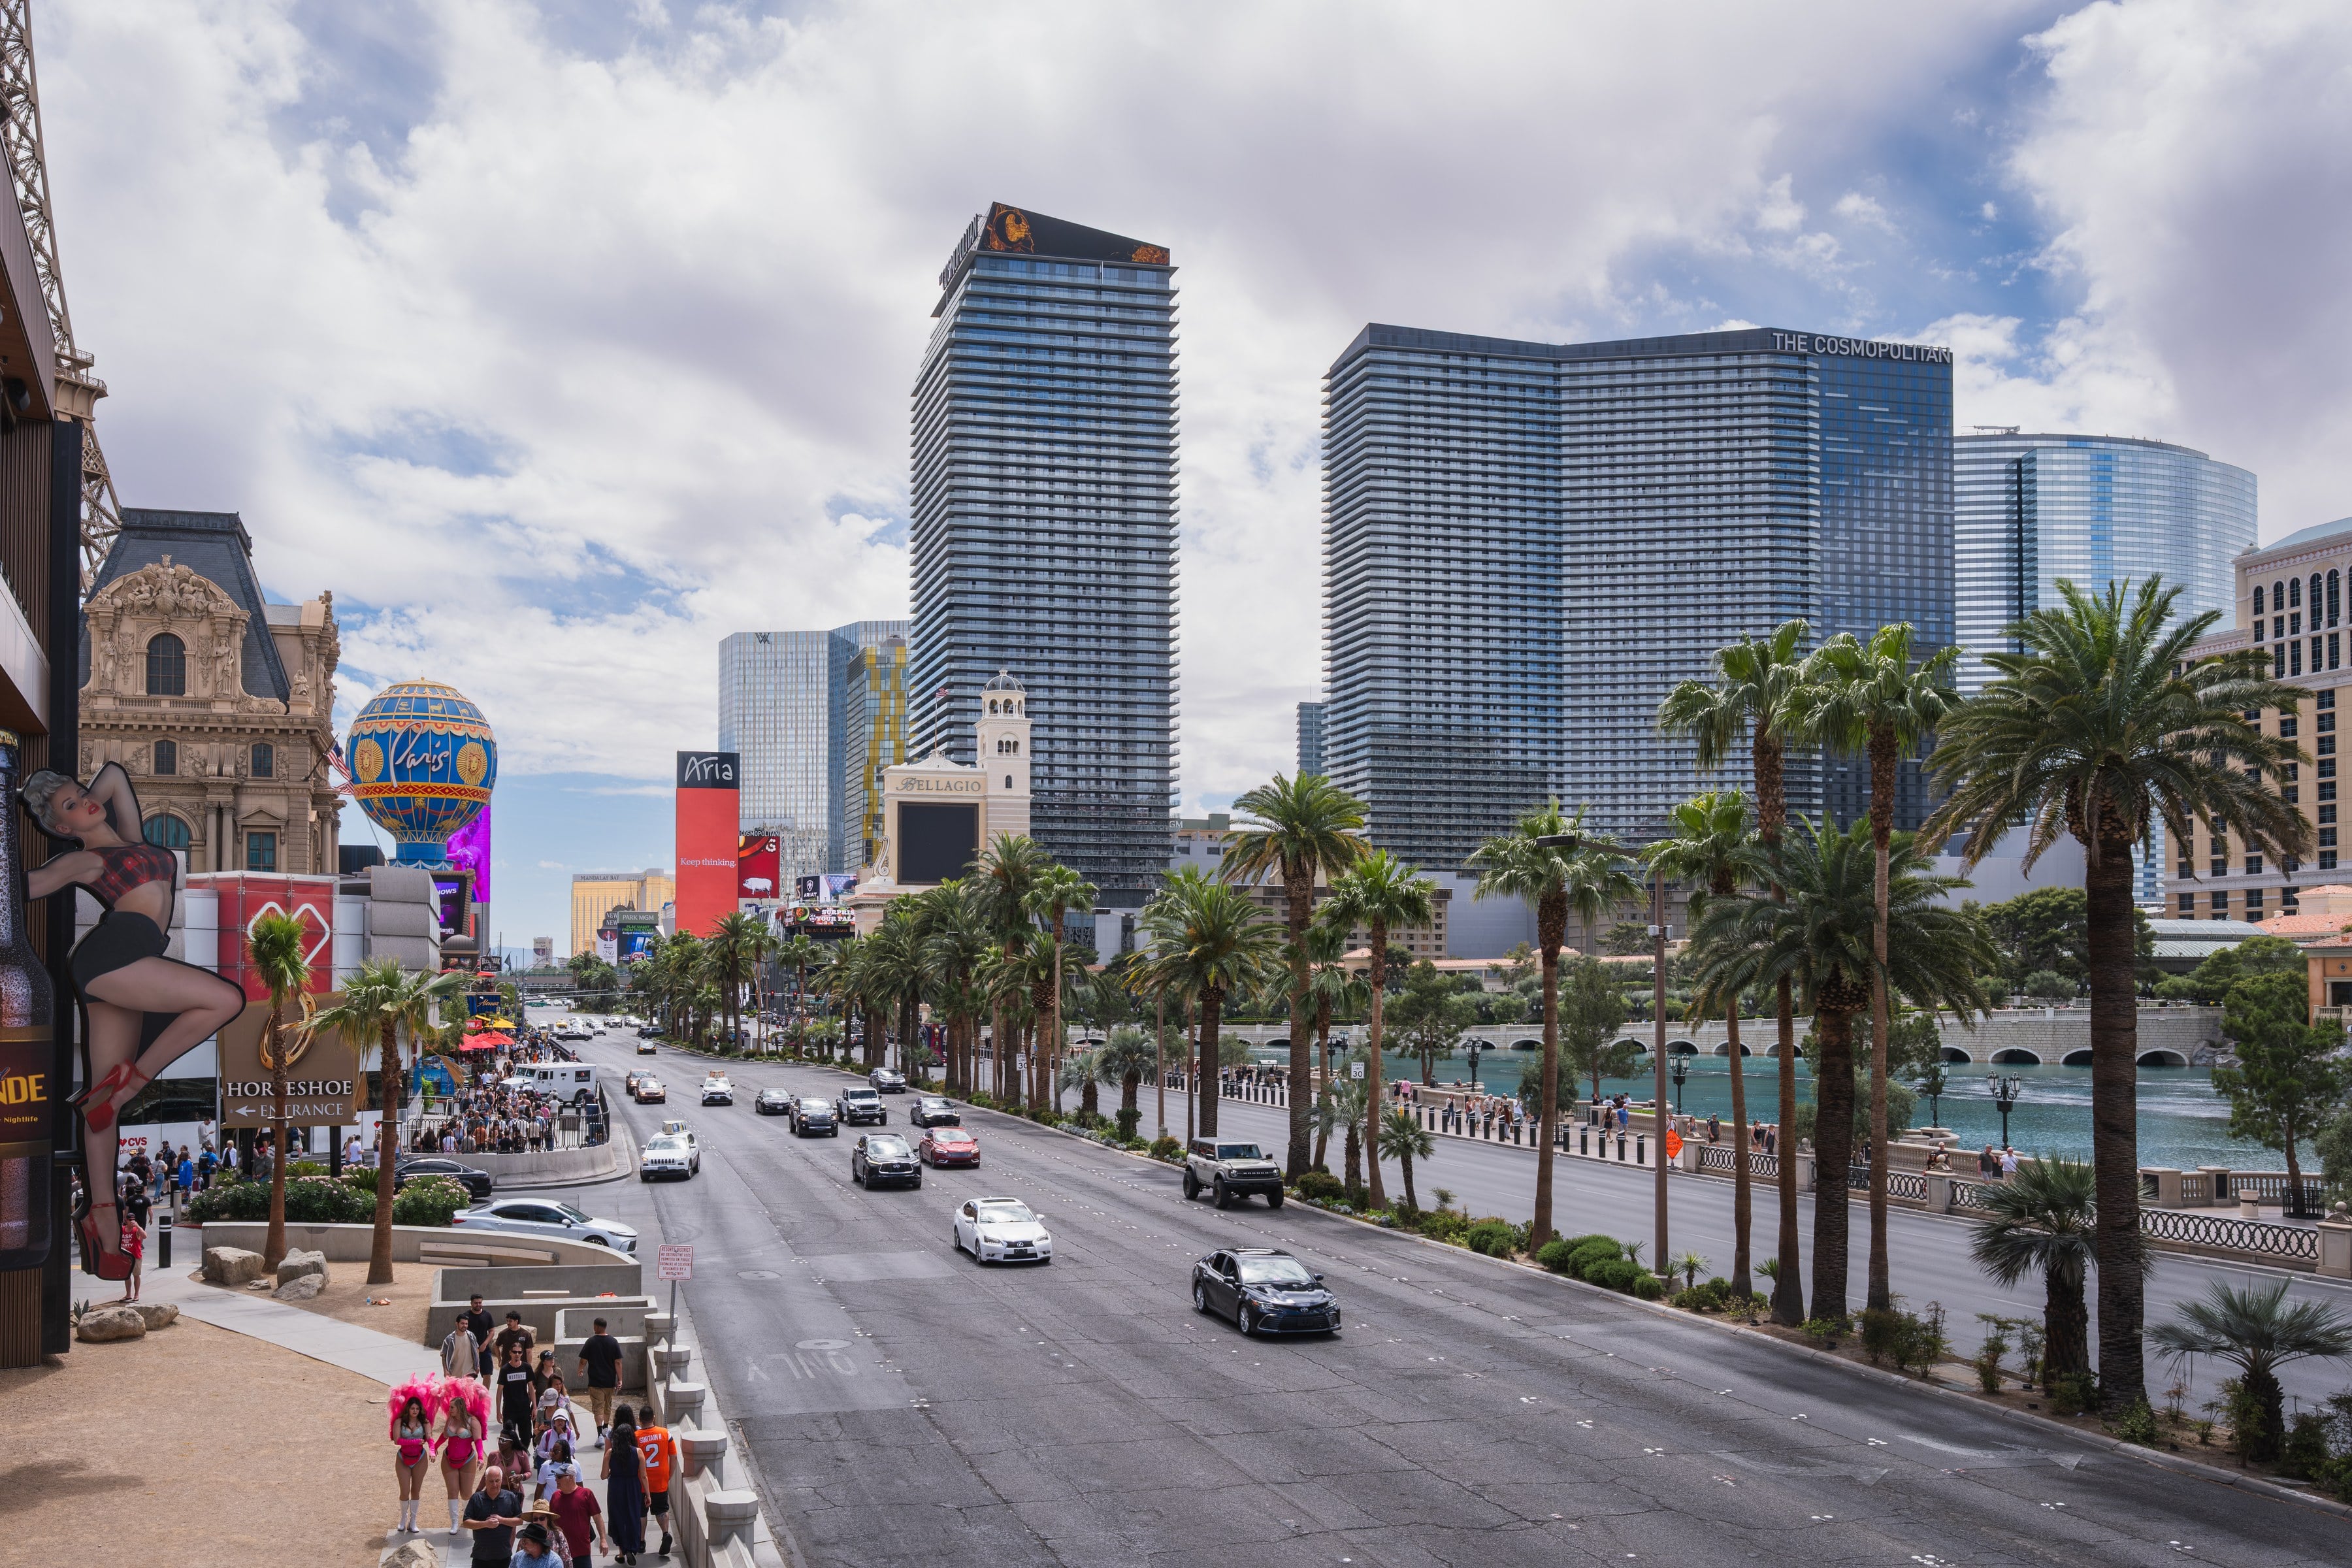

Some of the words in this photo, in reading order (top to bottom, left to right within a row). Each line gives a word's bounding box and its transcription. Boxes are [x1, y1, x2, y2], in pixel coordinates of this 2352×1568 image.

[1772, 333, 1808, 351] THE
[1814, 336, 1951, 363] COSMOPOLITAN
[391, 721, 449, 788] Paris
[684, 756, 733, 782] Aria
[896, 777, 981, 792] BELLAGIO
[680, 858, 701, 868] Keep
[702, 858, 736, 868] thinking.
[227, 1080, 353, 1097] HORESHOE
[127, 1137, 148, 1147] CVS
[746, 1350, 860, 1381] ONLY
[639, 1433, 659, 1444] SURTAIN
[645, 1443, 659, 1467] 2
